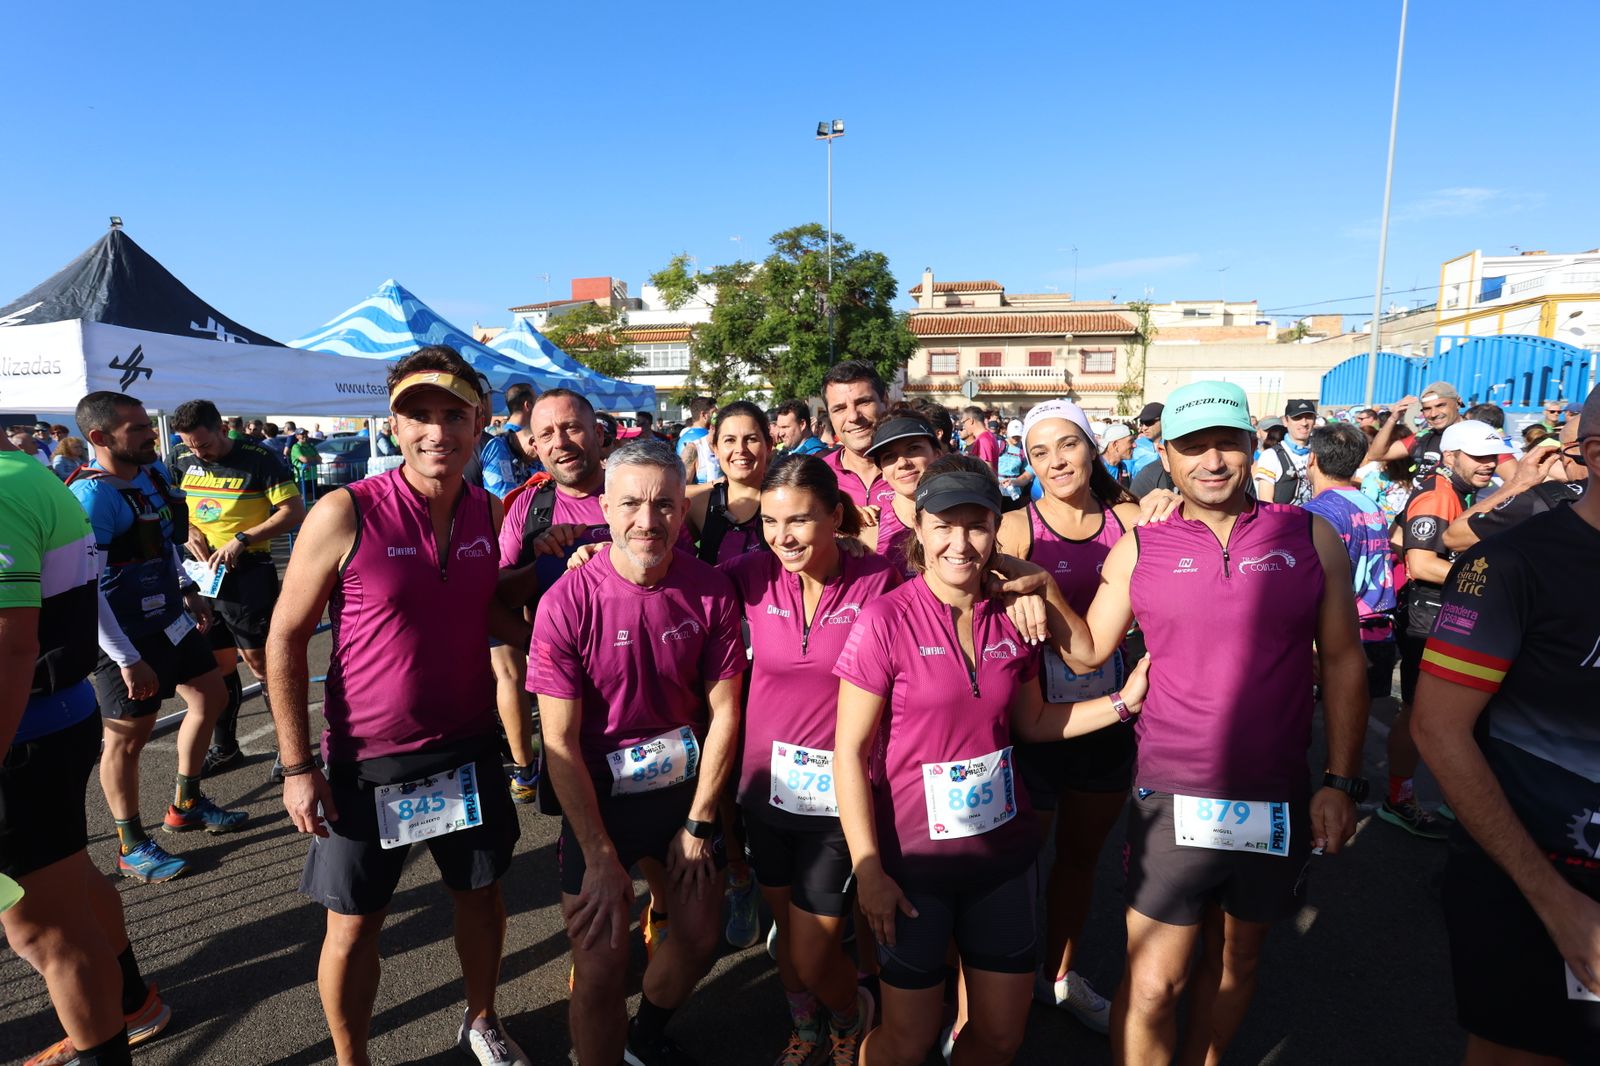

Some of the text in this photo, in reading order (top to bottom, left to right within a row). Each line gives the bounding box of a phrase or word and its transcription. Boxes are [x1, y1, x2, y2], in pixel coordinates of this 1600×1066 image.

[1175, 397, 1240, 415] SPEEDLAND
[1457, 580, 1485, 597] Eric
[632, 756, 673, 782] 856
[787, 769, 831, 793] 878
[398, 790, 446, 821] 845
[460, 765, 478, 823] PIRATILLA
[949, 780, 994, 811] 865
[420, 816, 441, 826] ALBERTO
[1197, 798, 1251, 825] 879
